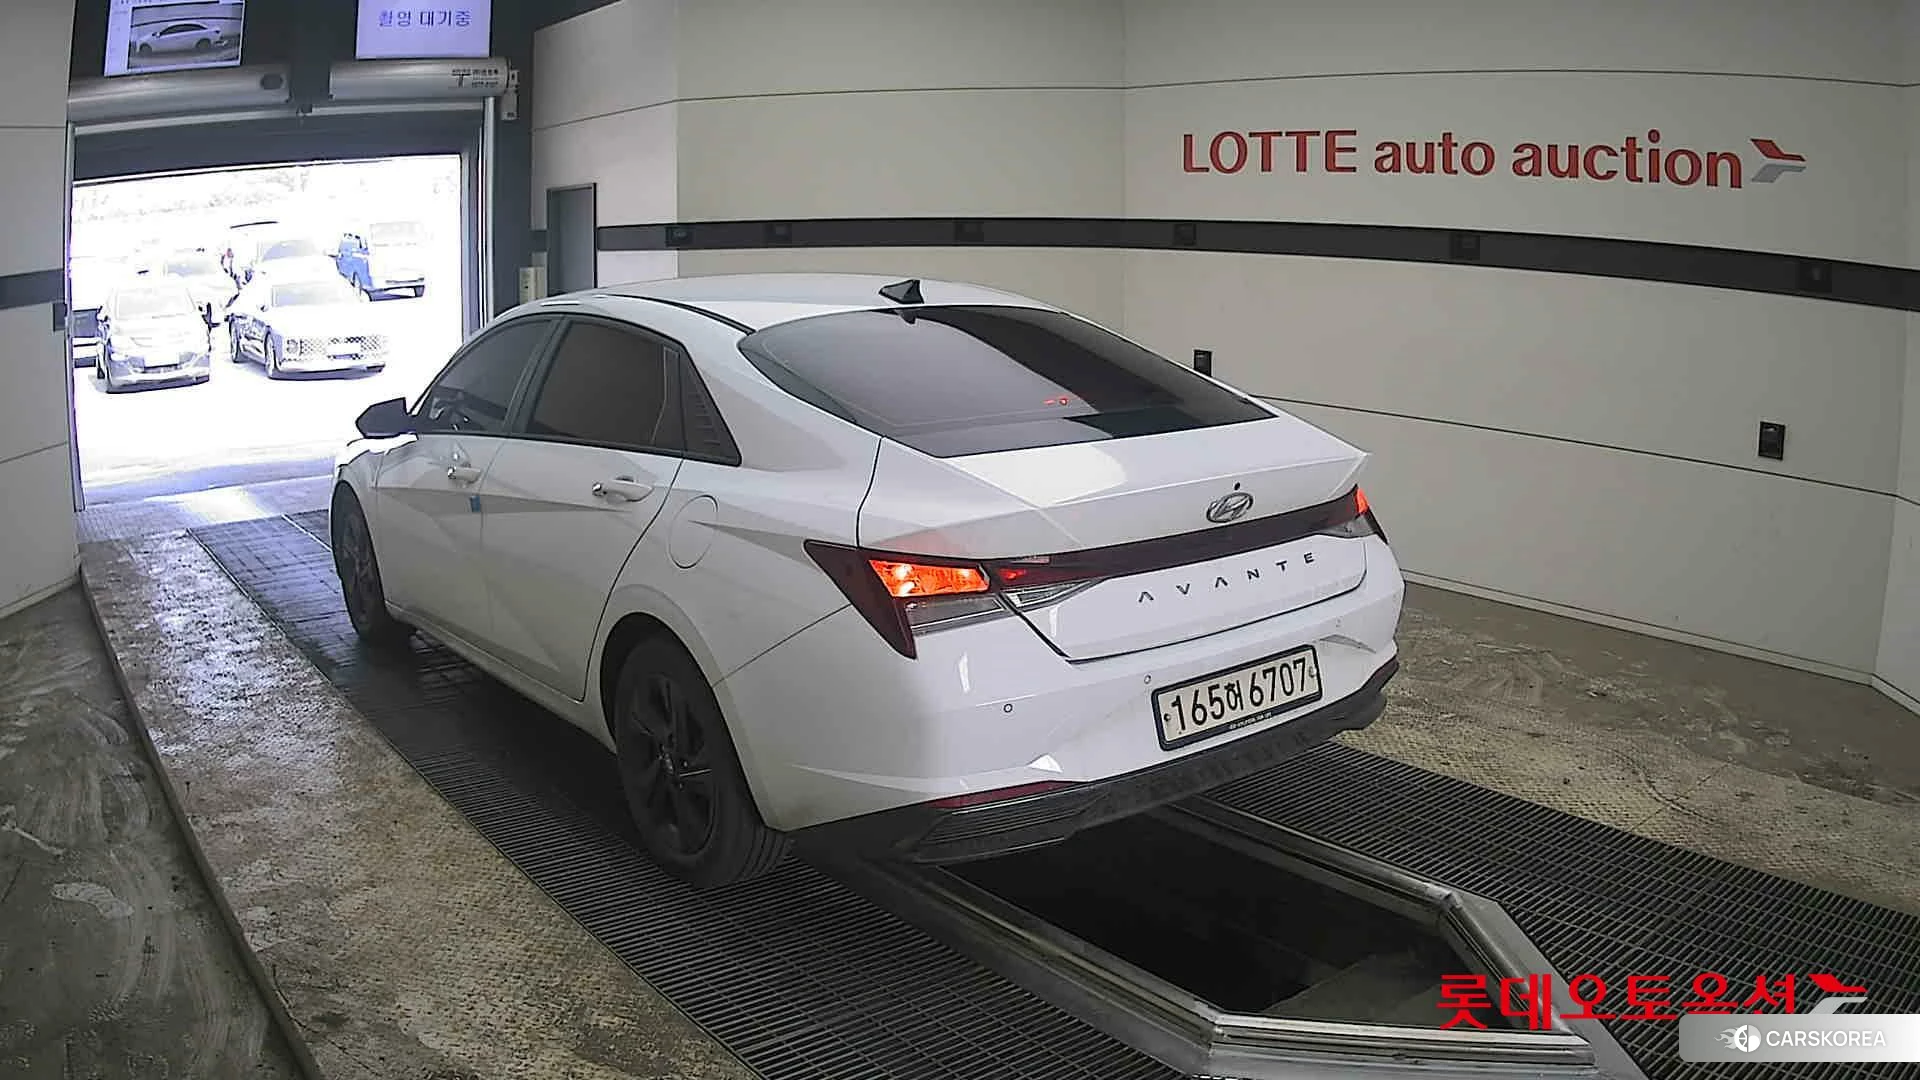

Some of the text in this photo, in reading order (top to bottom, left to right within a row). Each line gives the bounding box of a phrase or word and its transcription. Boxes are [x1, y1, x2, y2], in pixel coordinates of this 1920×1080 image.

[419, 10, 473, 28] 대기중
[1183, 128, 1743, 189] LOTTE auto auction
[1138, 552, 1315, 604] AVANTE
